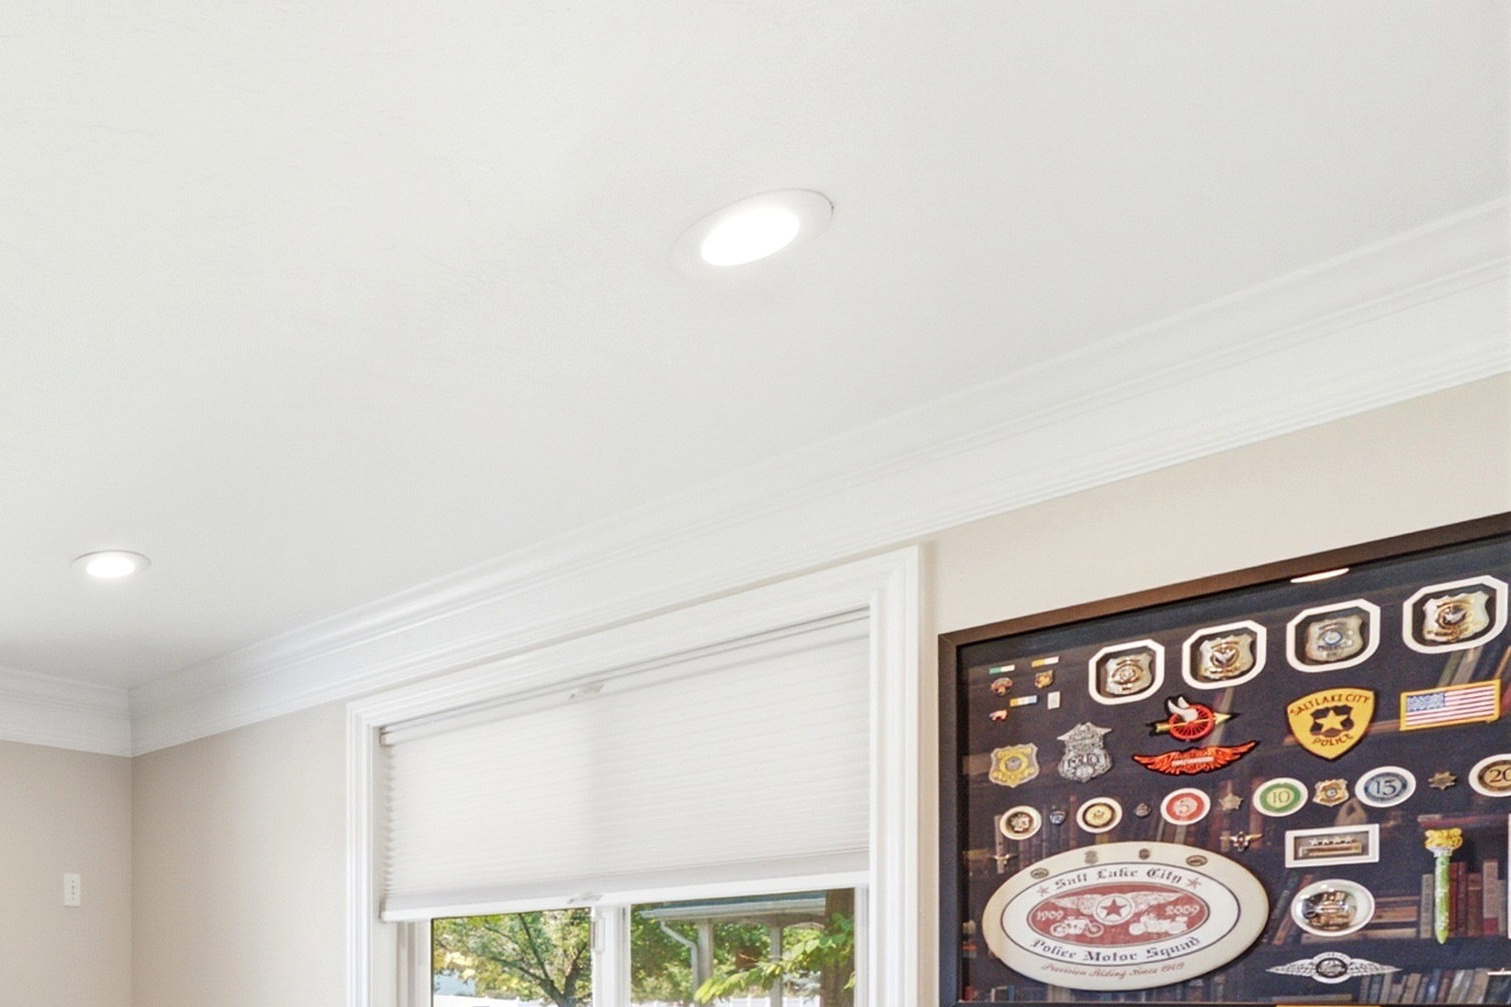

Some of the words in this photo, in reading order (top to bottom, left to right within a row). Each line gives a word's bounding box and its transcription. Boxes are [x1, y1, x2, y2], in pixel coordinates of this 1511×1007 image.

[1289, 700, 1314, 716] SALT
[1314, 694, 1343, 706] LAKE
[1345, 693, 1371, 704] CITY
[1312, 733, 1354, 747] POLICE
[1375, 780, 1397, 794] 15
[1272, 790, 1291, 805] 10
[1178, 798, 1191, 814] 5
[1054, 872, 1088, 890] Salt
[1097, 866, 1139, 880] Lake
[1145, 866, 1183, 884] City
[1035, 909, 1065, 921] 1909
[1164, 904, 1201, 917] 2009
[1029, 938, 1078, 960] Police
[1082, 950, 1138, 963] Motor
[1145, 935, 1201, 960] Squad
